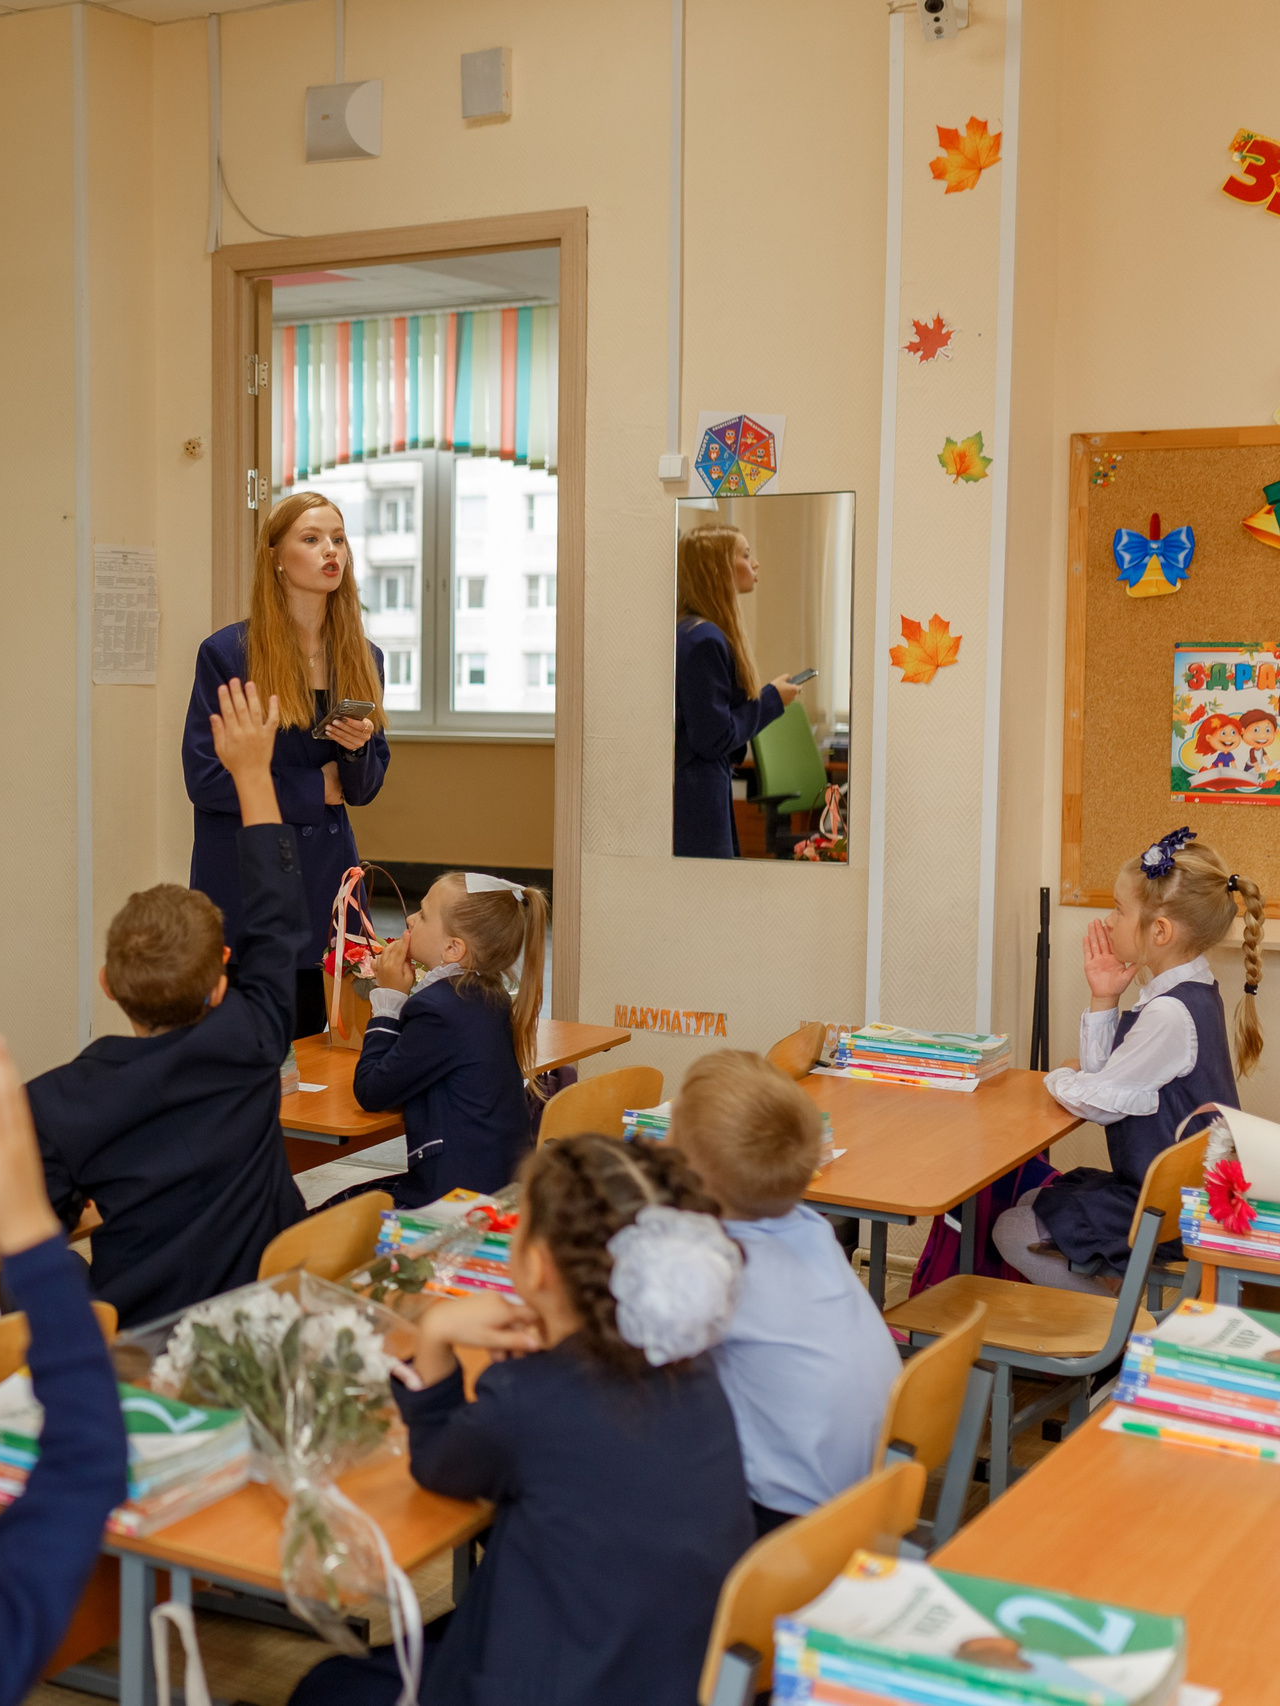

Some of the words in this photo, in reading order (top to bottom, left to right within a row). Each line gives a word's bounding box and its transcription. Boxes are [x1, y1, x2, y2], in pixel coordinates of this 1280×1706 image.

[1187, 662, 1278, 692] ЗДРА
[614, 1004, 728, 1037] МАКУЛАТУРА
[995, 1595, 1136, 1656] 2
